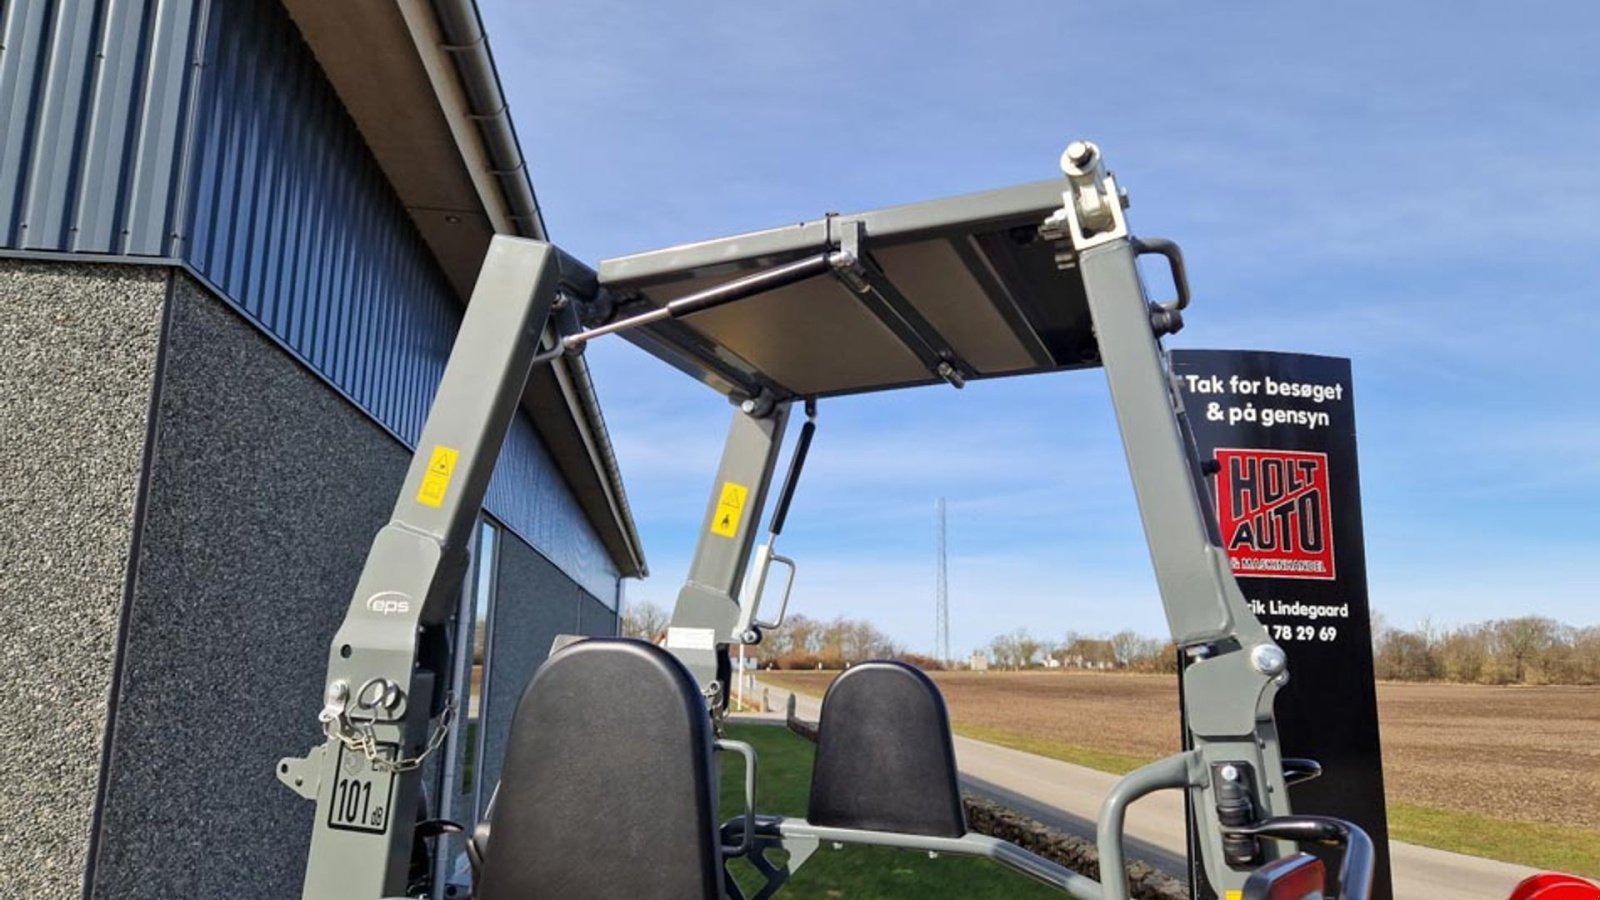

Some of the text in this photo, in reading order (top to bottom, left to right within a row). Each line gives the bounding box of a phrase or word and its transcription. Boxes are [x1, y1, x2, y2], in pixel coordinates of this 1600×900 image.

[1186, 375, 1343, 402] Tak for besøget
[1207, 402, 1330, 429] & på gensyn
[1229, 456, 1319, 521] HOLT
[1228, 488, 1325, 554] AUTO
[372, 600, 409, 616] eps
[1270, 600, 1349, 619] Lindegaard
[1273, 624, 1292, 640] 78
[1296, 625, 1315, 641] 29
[1319, 626, 1337, 641] 69
[338, 778, 384, 826] 101 dB
